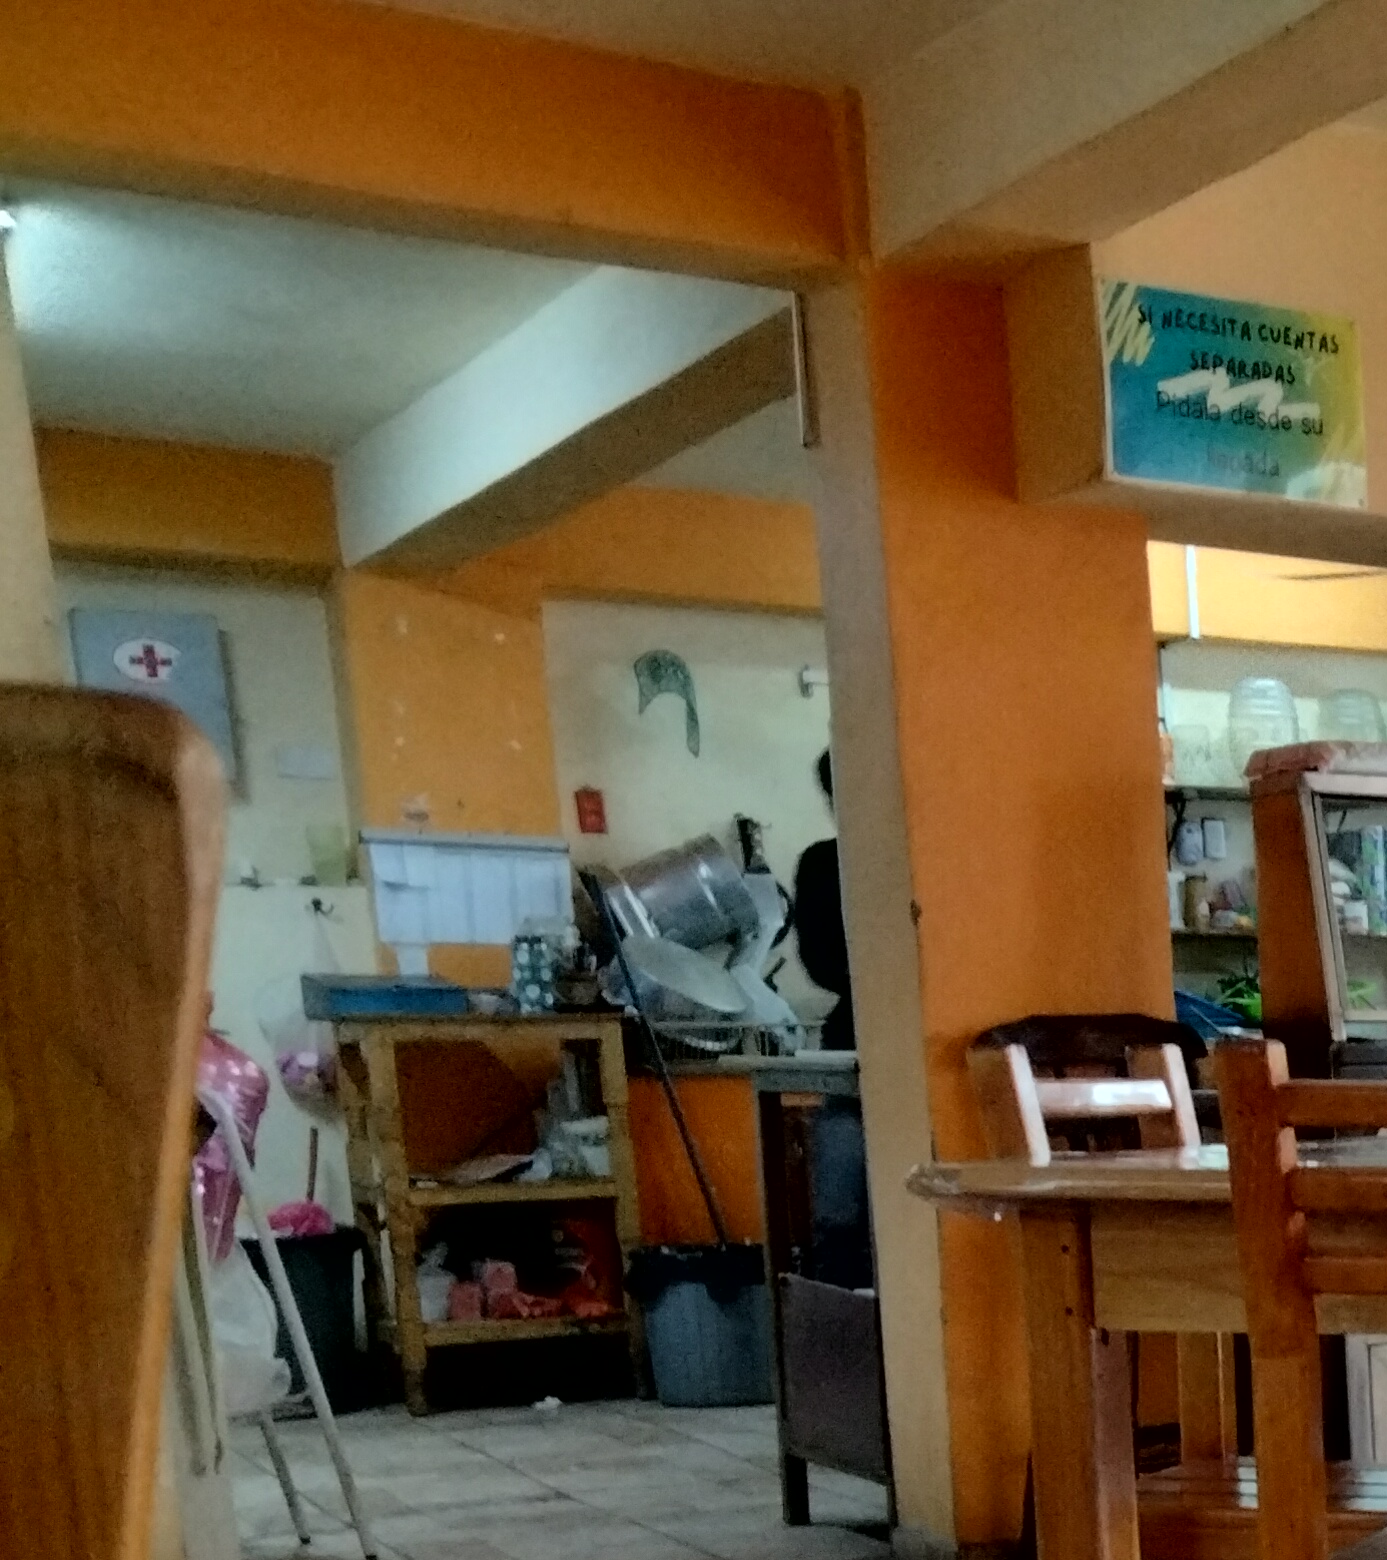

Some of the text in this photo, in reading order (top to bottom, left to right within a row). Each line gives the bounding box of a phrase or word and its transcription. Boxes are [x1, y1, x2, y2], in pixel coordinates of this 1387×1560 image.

[1161, 308, 1252, 342] NECESITA
[1258, 323, 1339, 355] CUENTAS
[1190, 351, 1296, 385] SEPARADAS
[1231, 401, 1293, 431] desde
[1302, 416, 1324, 436] su
